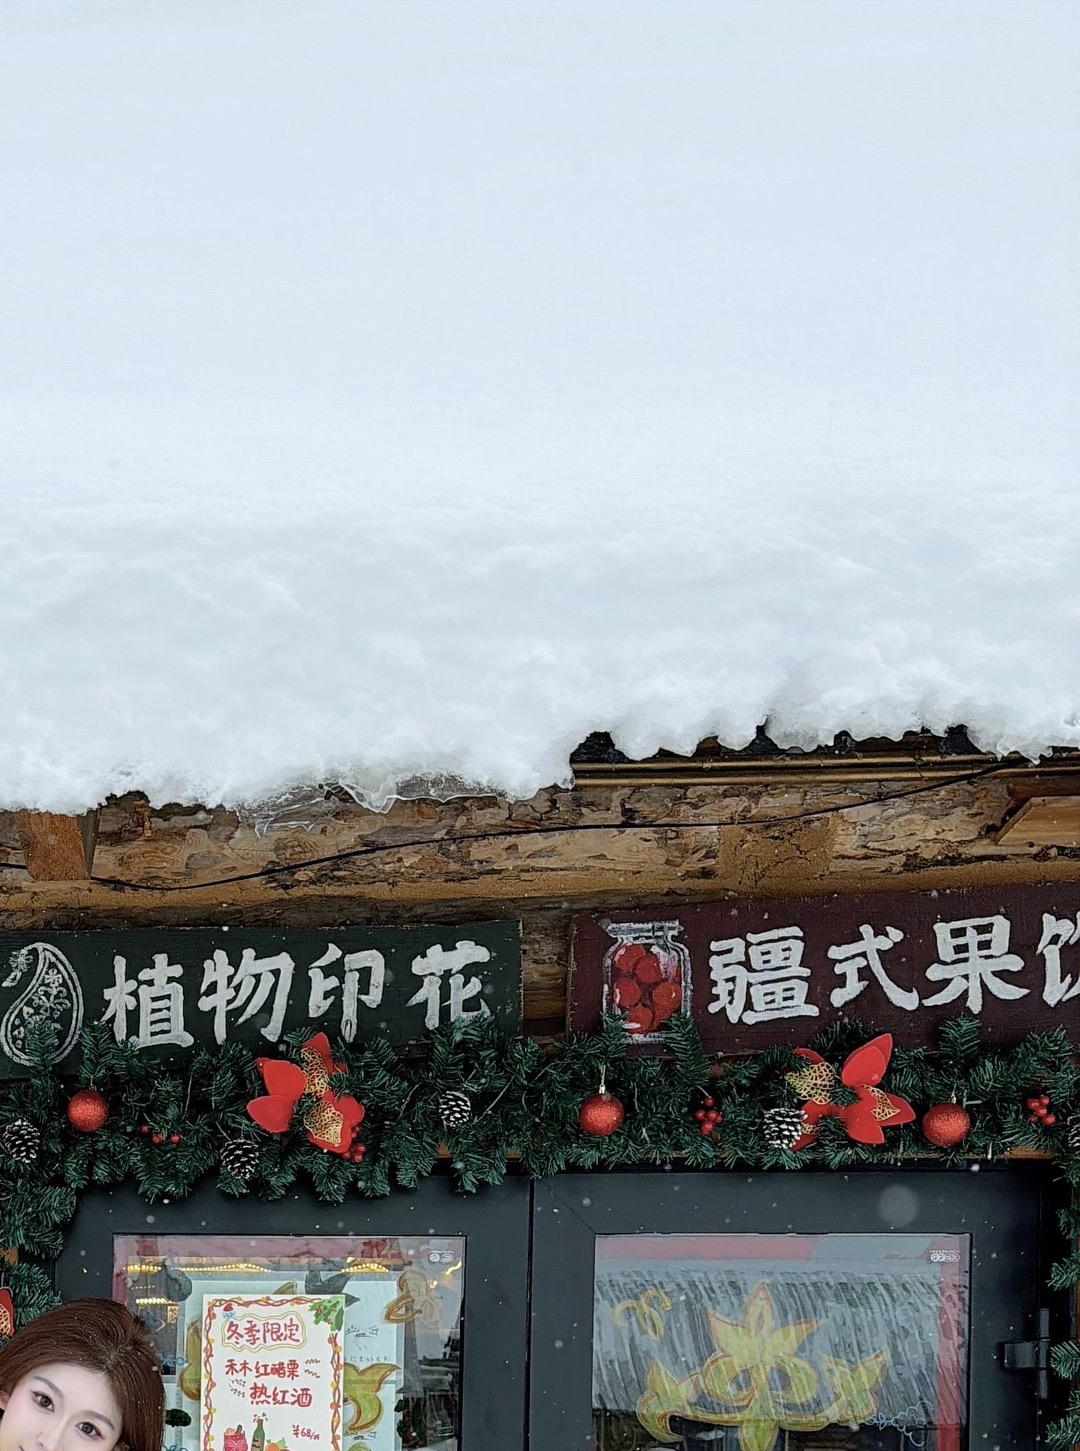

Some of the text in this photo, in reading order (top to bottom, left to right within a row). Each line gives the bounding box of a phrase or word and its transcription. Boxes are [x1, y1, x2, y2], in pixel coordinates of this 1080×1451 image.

[101, 939, 493, 1049] 植物印花
[226, 1318, 300, 1346] 冬季限定
[249, 1381, 313, 1408] 热红酒
